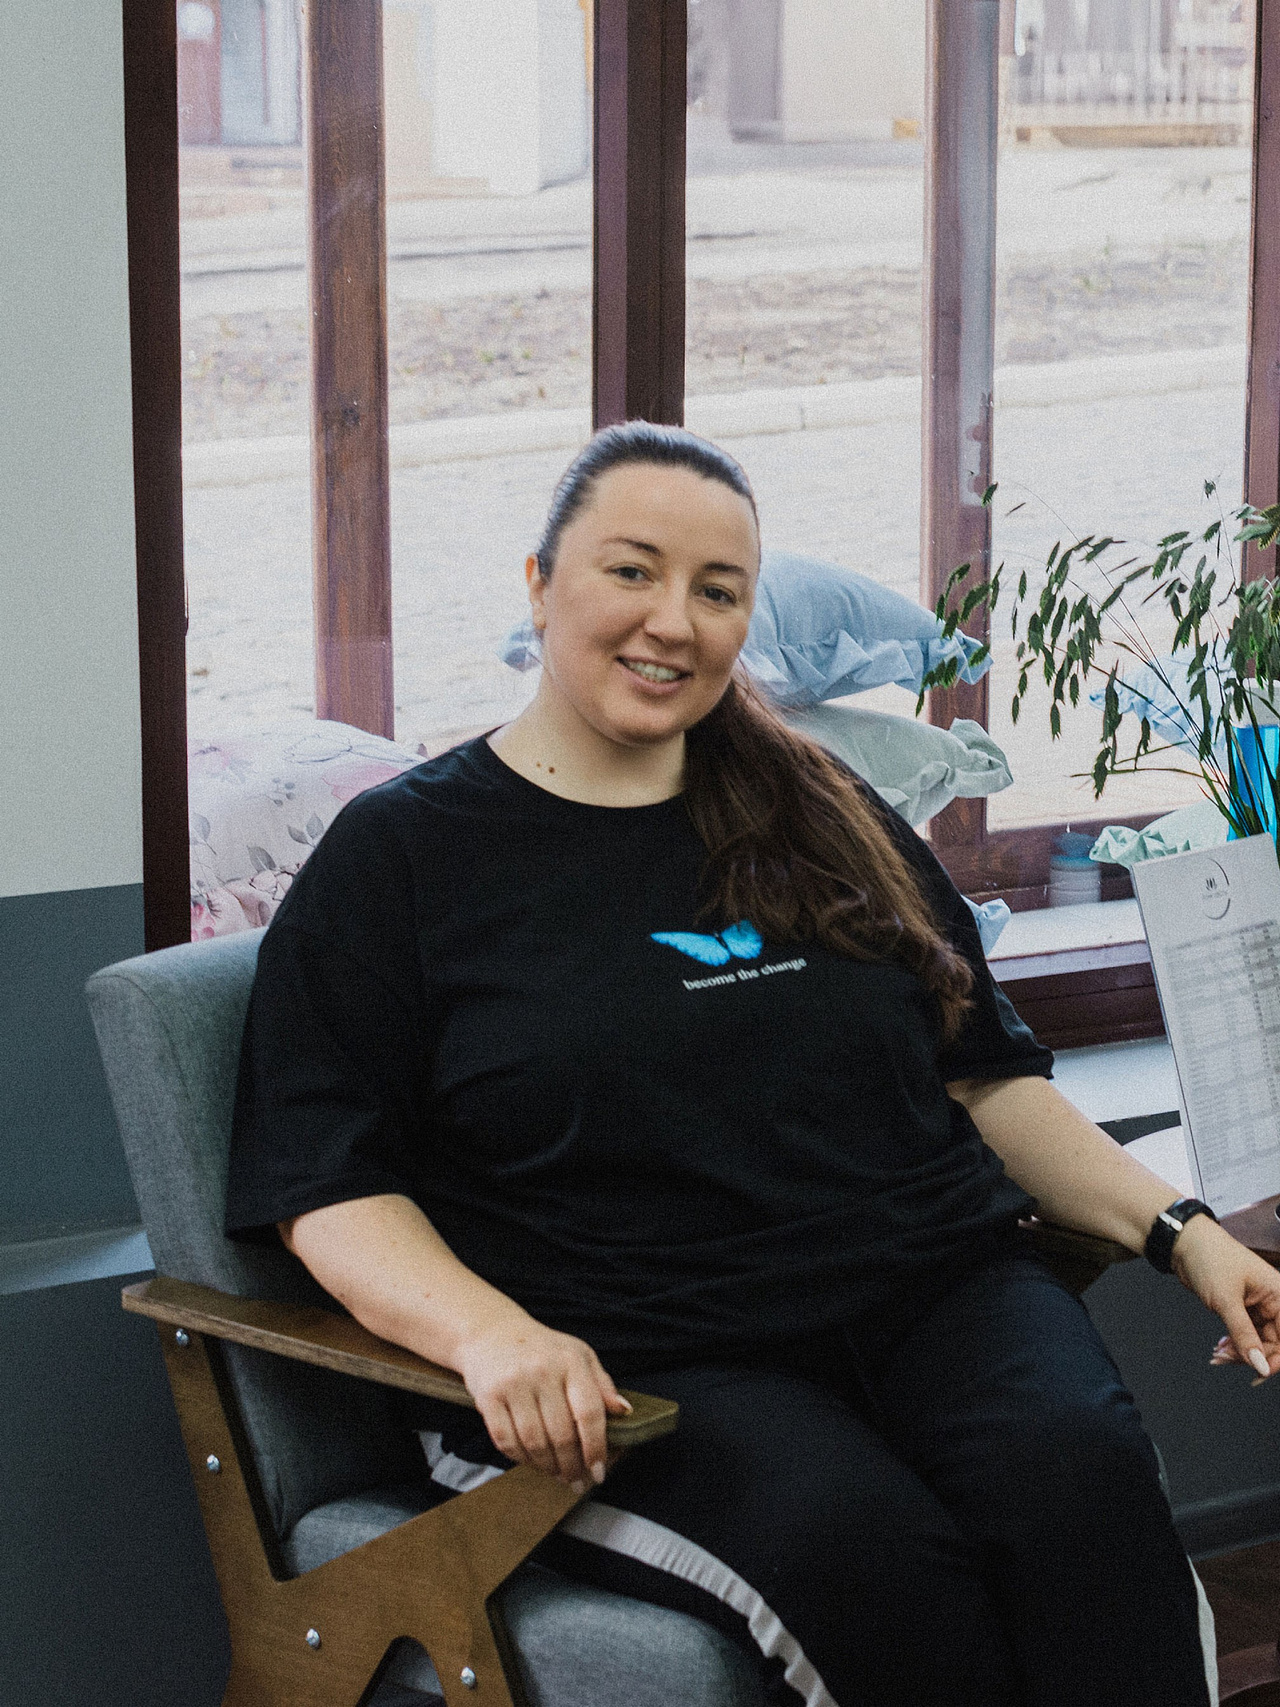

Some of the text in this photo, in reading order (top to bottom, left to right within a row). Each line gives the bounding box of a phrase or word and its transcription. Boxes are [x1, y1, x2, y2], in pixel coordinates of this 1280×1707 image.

[682, 957, 807, 990] become the change
